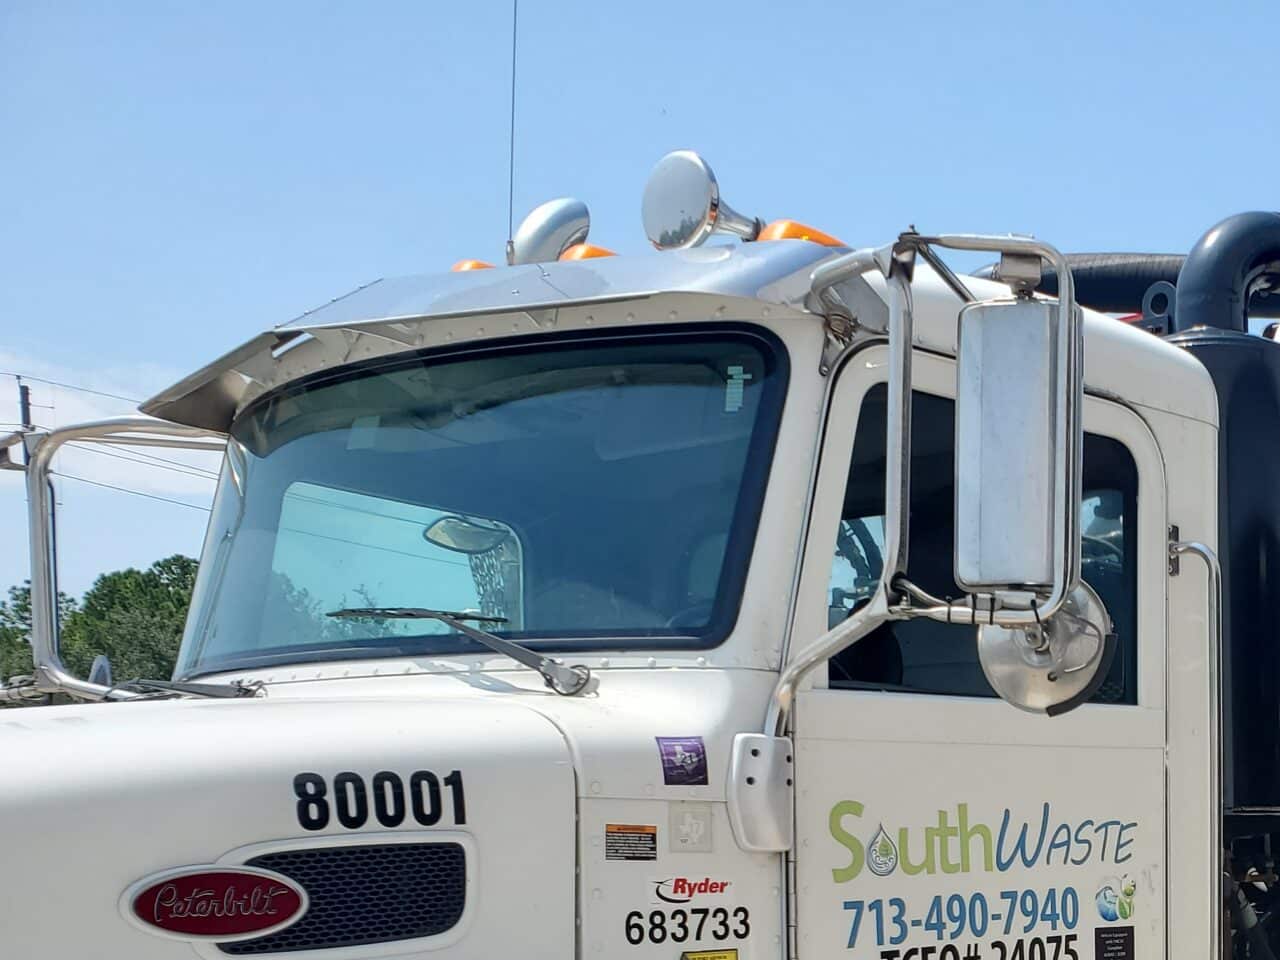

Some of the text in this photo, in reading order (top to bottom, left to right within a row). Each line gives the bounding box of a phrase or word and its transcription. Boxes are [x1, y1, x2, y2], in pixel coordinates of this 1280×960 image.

[293, 770, 466, 831] 80001
[154, 884, 288, 922] Peterbilt
[673, 877, 728, 898] Ryder
[625, 906, 750, 945] 683733
[843, 887, 1079, 949] 713-490-7940
